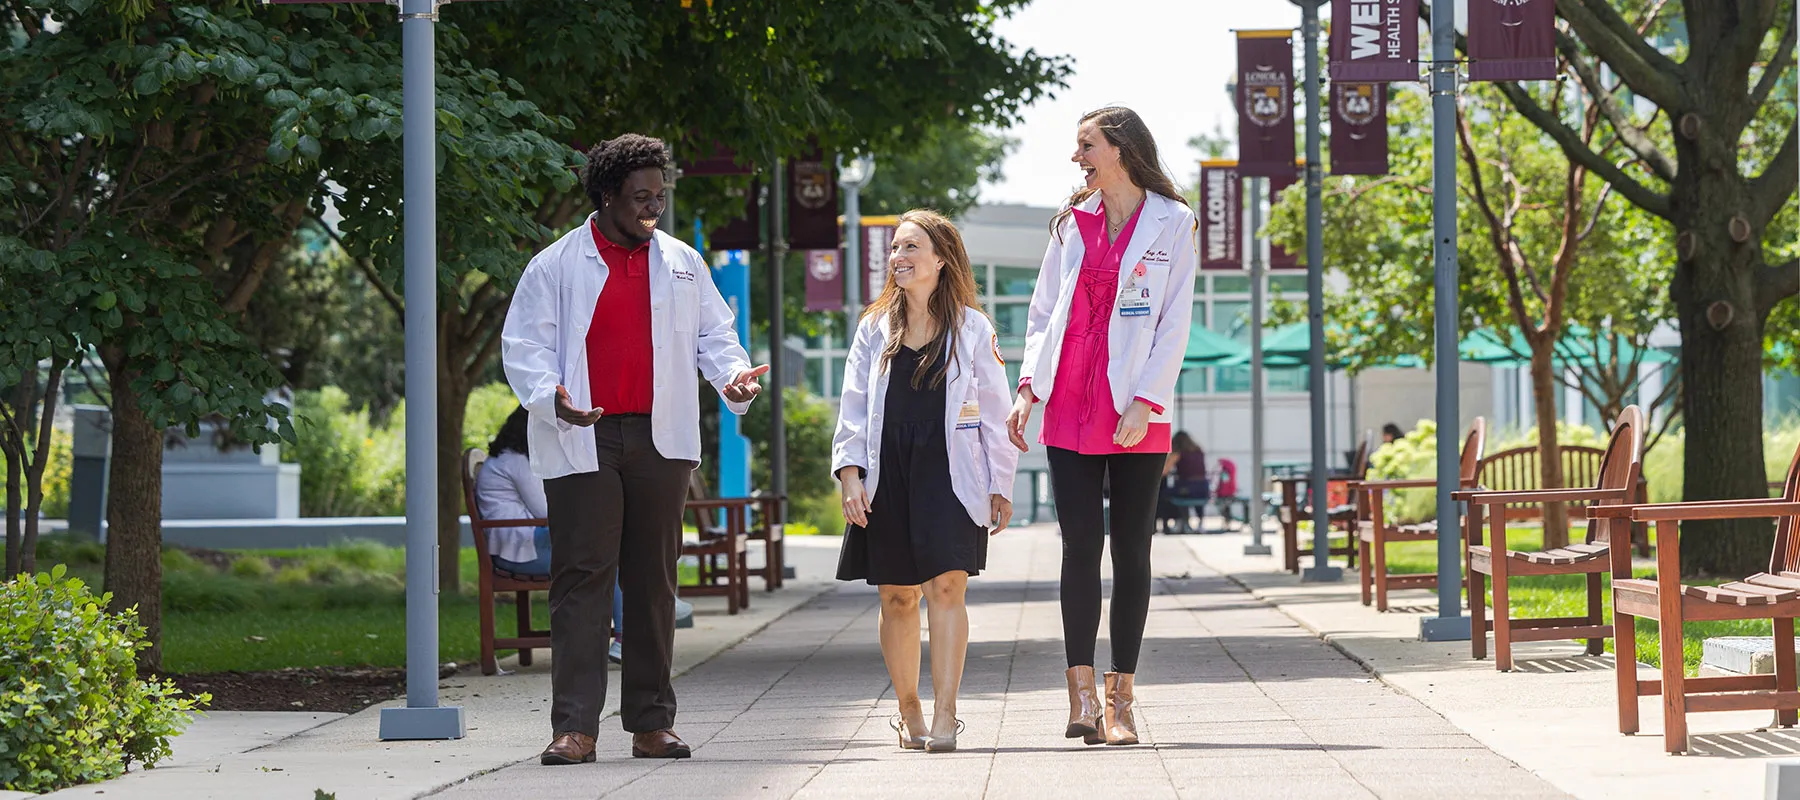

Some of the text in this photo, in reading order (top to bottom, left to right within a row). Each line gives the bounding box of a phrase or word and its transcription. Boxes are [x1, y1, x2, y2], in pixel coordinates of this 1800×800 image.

[1351, 0, 1380, 60] WE
[1387, 7, 1400, 58] HEALTH
[1207, 169, 1226, 261] WELCOME
